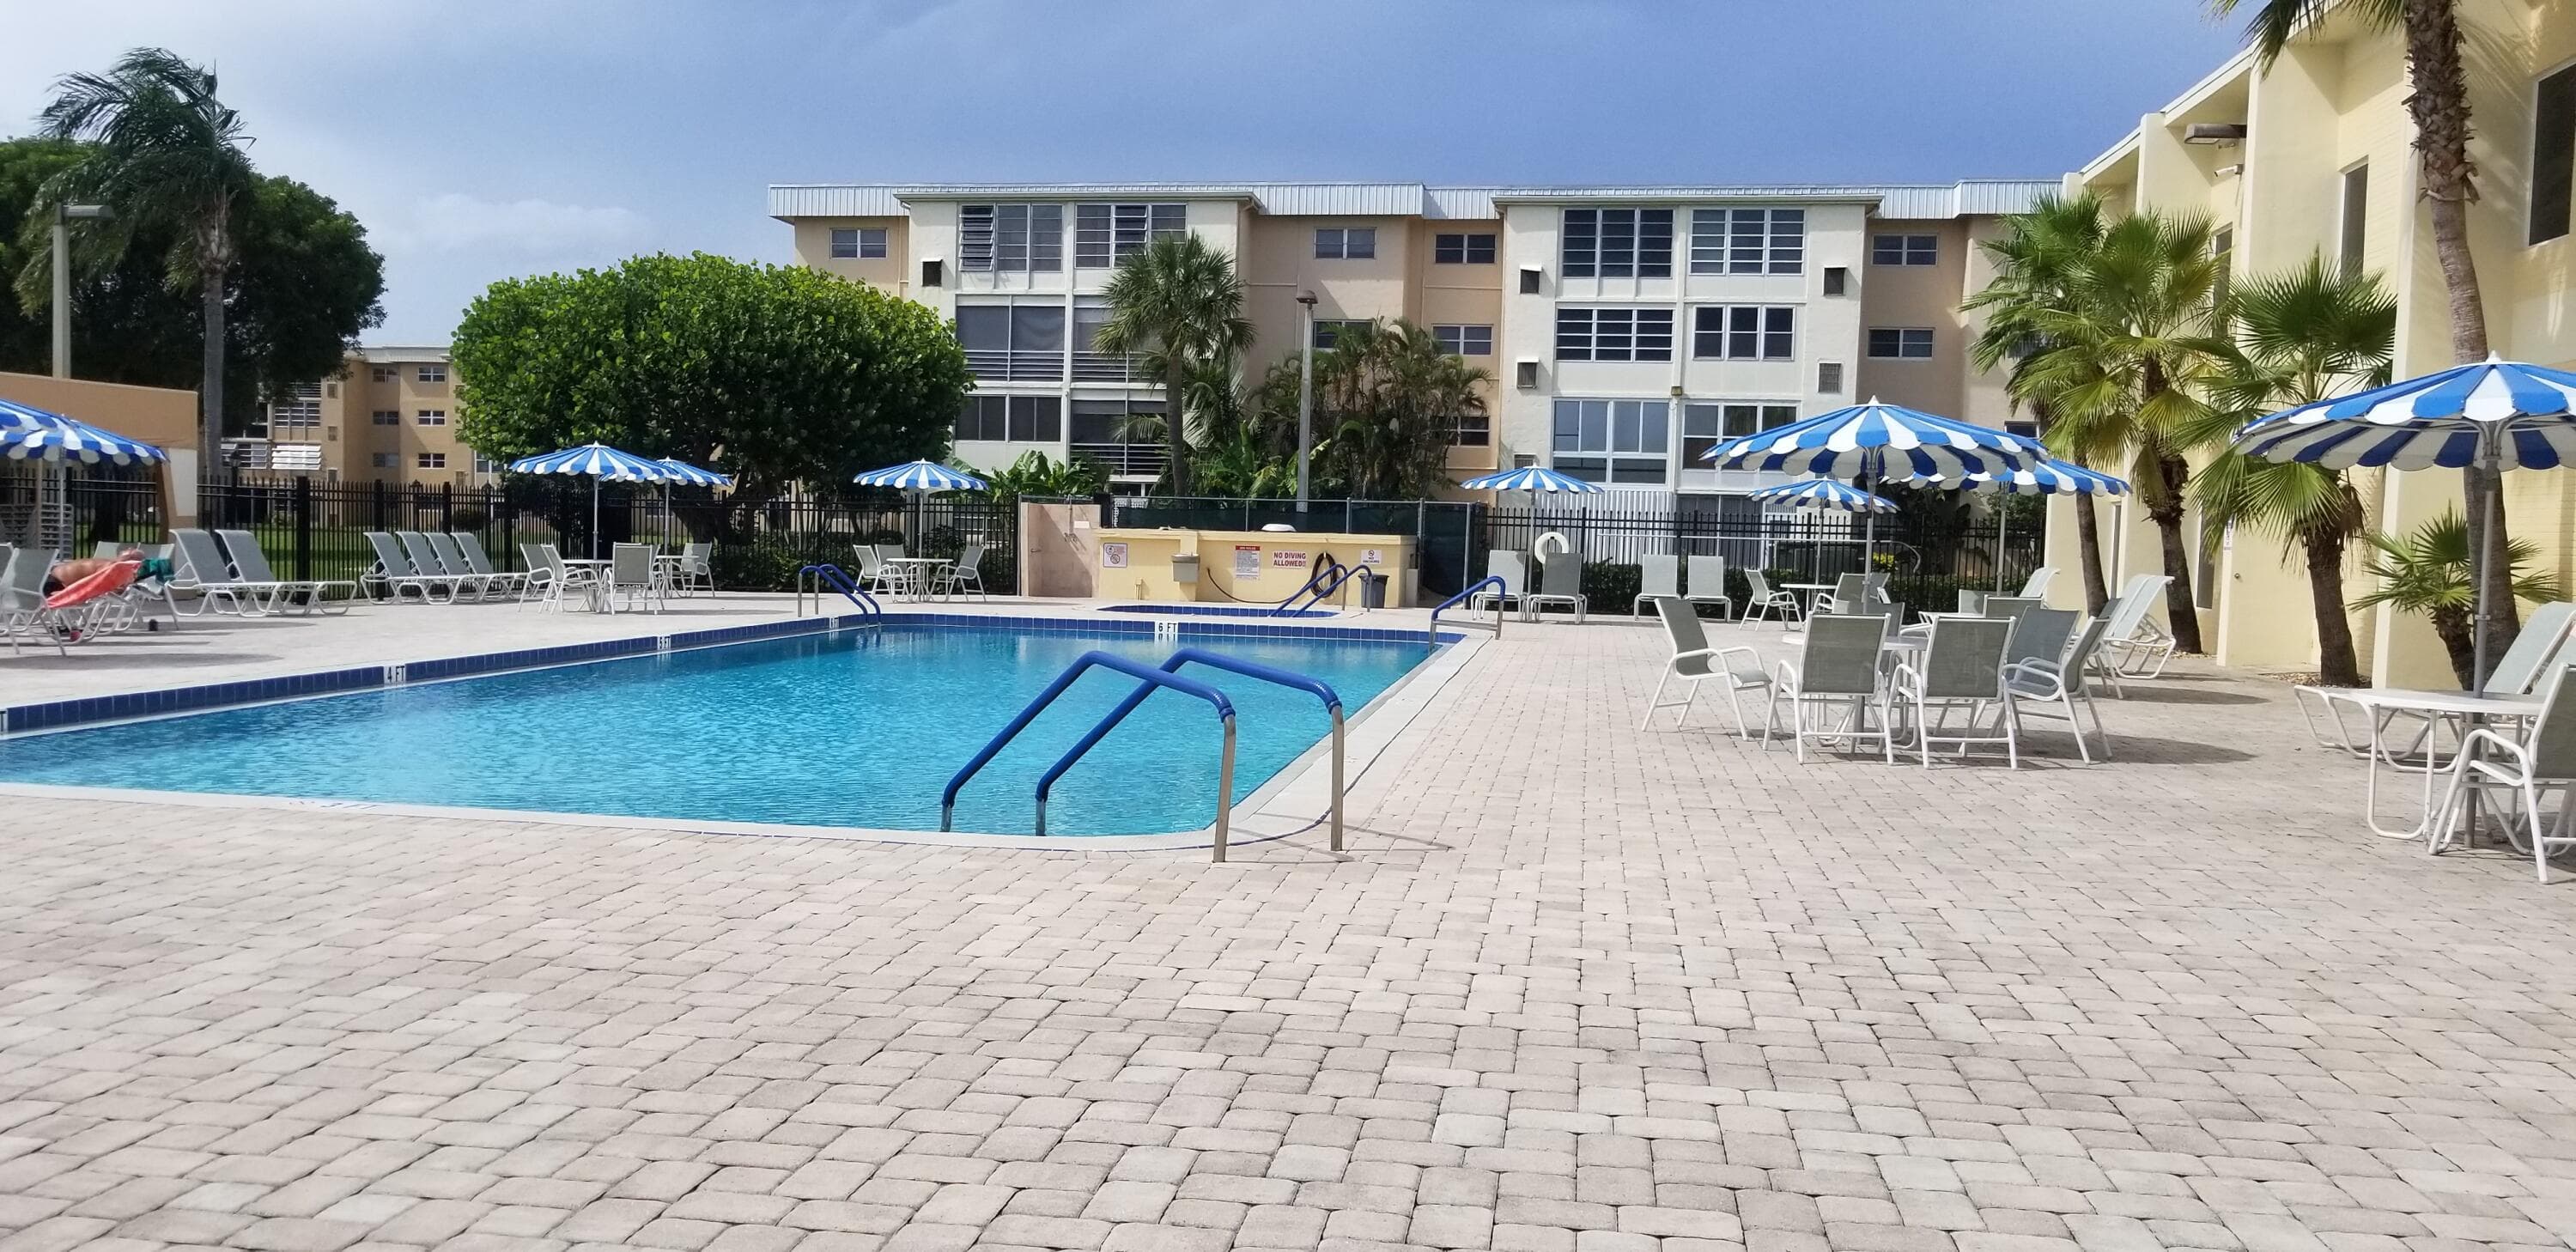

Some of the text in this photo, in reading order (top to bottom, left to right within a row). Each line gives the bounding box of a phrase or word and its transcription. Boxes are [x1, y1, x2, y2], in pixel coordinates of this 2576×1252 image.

[1158, 622, 1177, 633] 6 FT
[664, 635, 671, 649] FT
[387, 665, 405, 683] 4 FT
